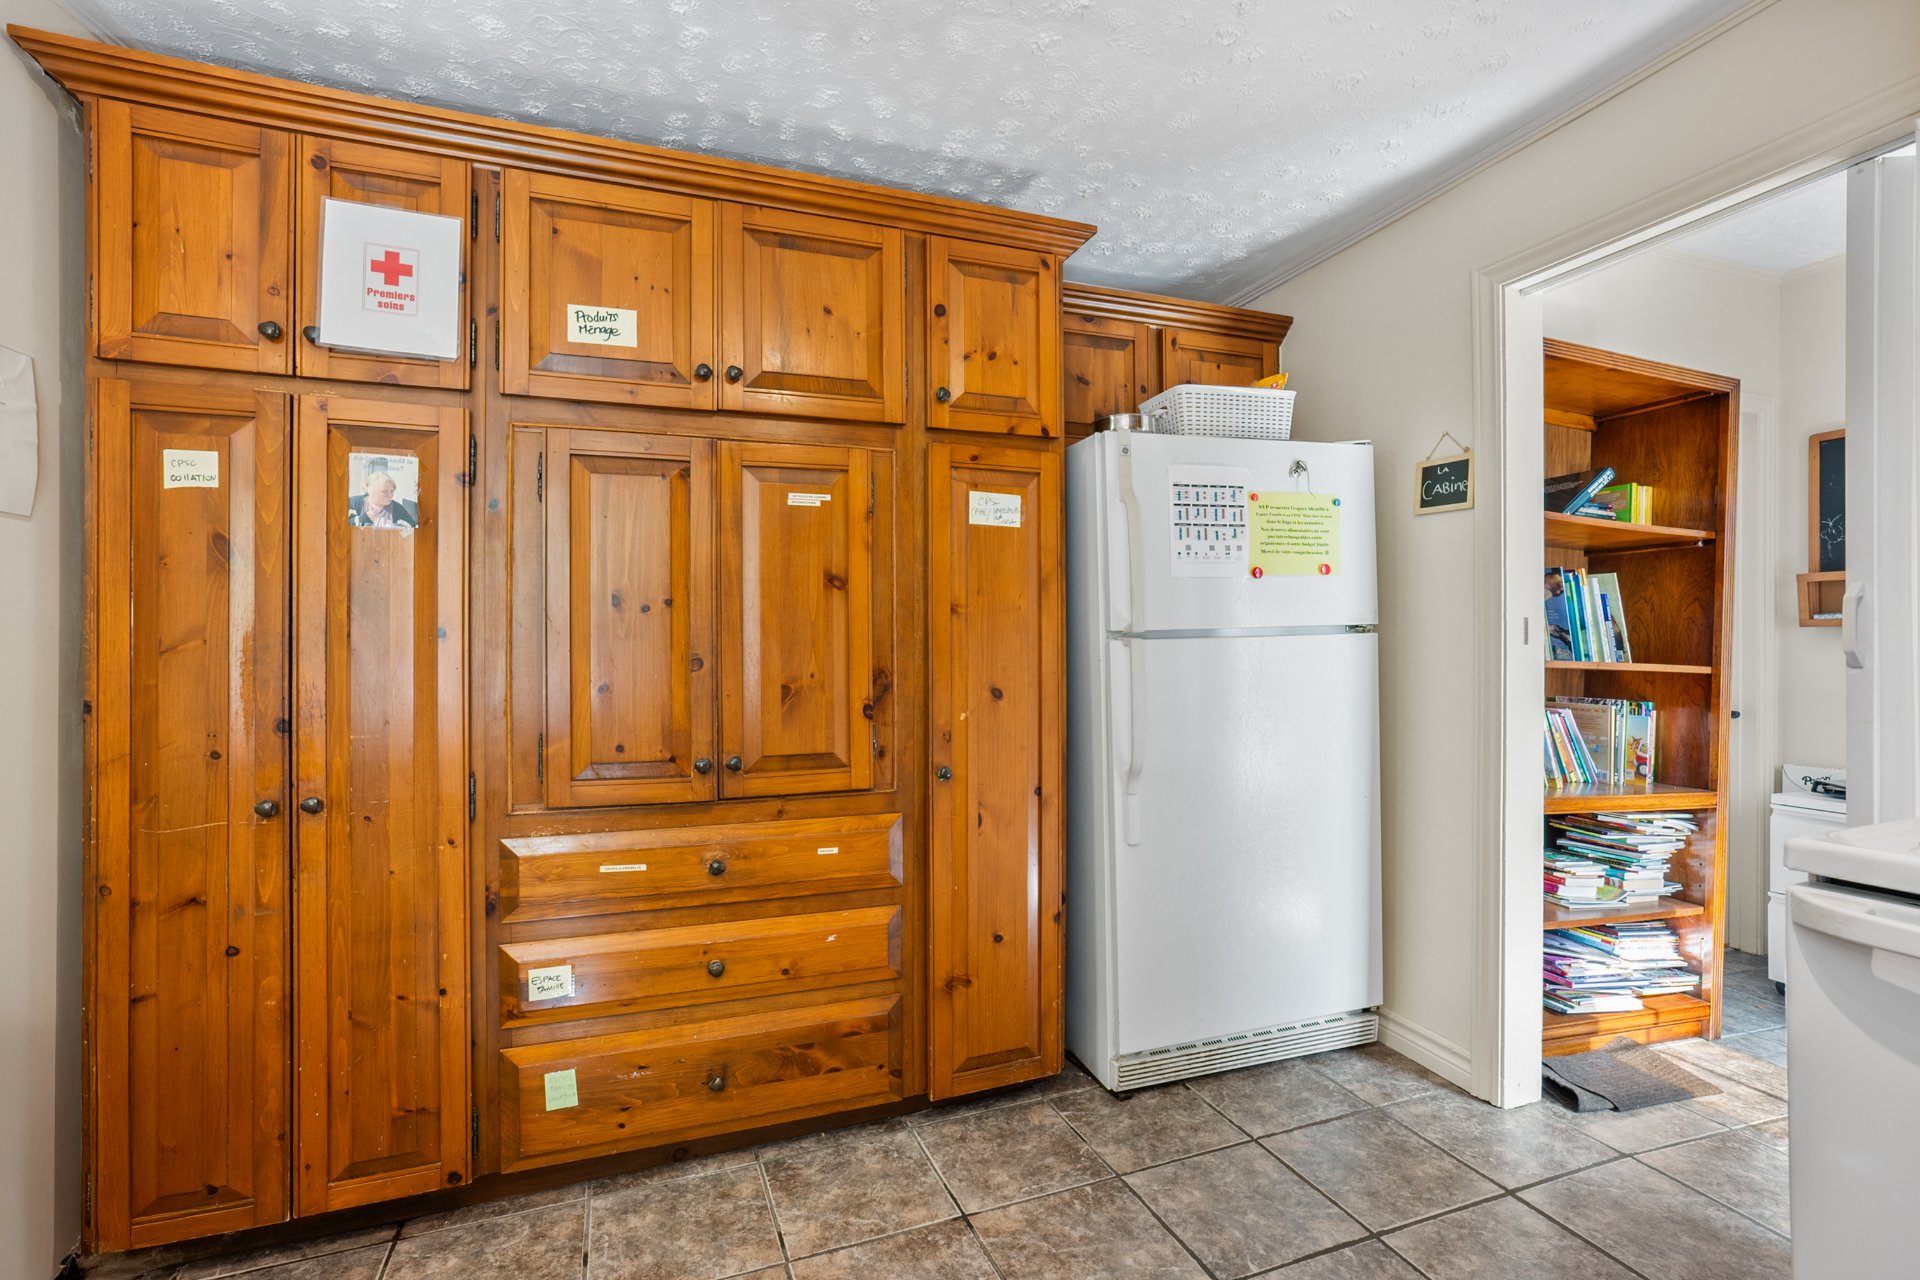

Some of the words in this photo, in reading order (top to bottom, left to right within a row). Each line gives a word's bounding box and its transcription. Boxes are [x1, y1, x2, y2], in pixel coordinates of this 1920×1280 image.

[366, 287, 416, 302] Premiers
[377, 300, 405, 311] soins
[574, 310, 619, 323] Produits
[1437, 466, 1450, 475] LA
